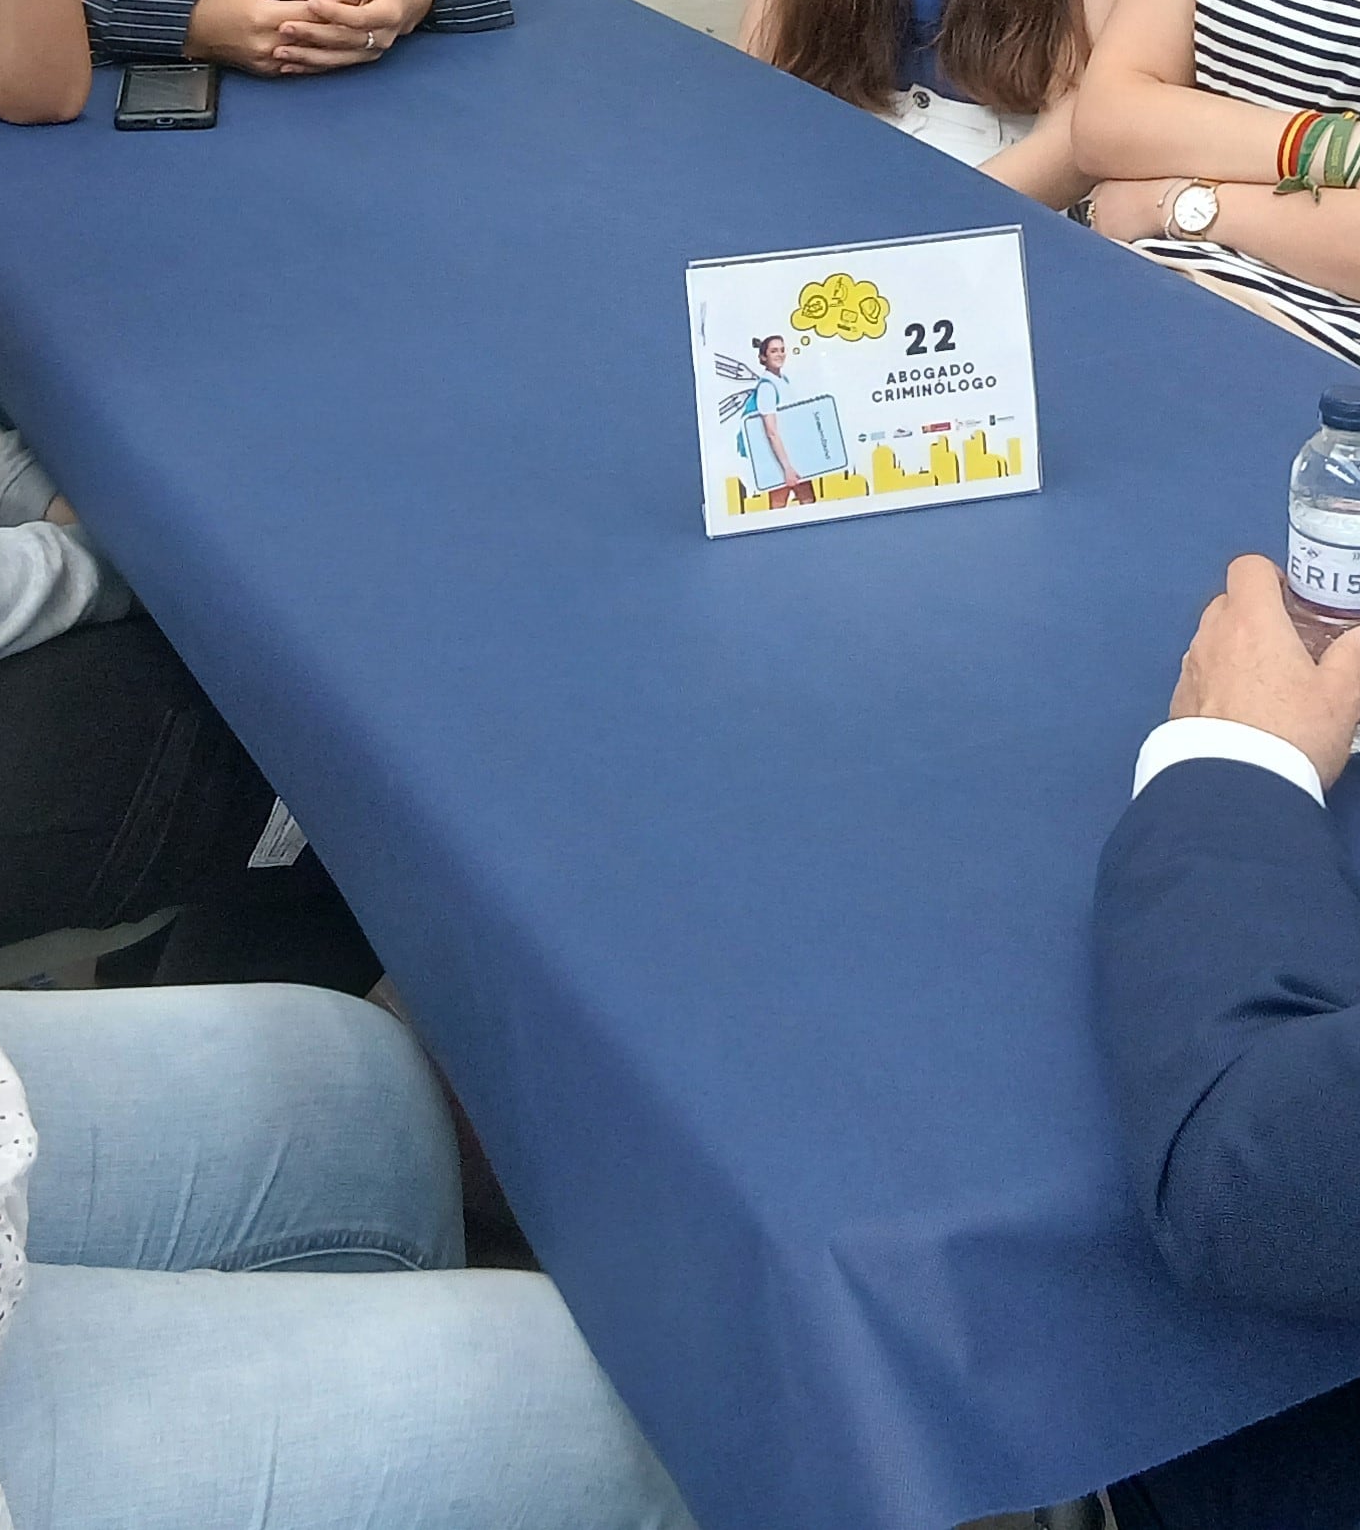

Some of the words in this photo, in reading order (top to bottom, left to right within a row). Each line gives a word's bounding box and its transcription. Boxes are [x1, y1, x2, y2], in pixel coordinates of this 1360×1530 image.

[905, 319, 956, 356] 22
[886, 362, 975, 385] ABOGADO
[871, 376, 997, 403] CRIMINÓLOGO
